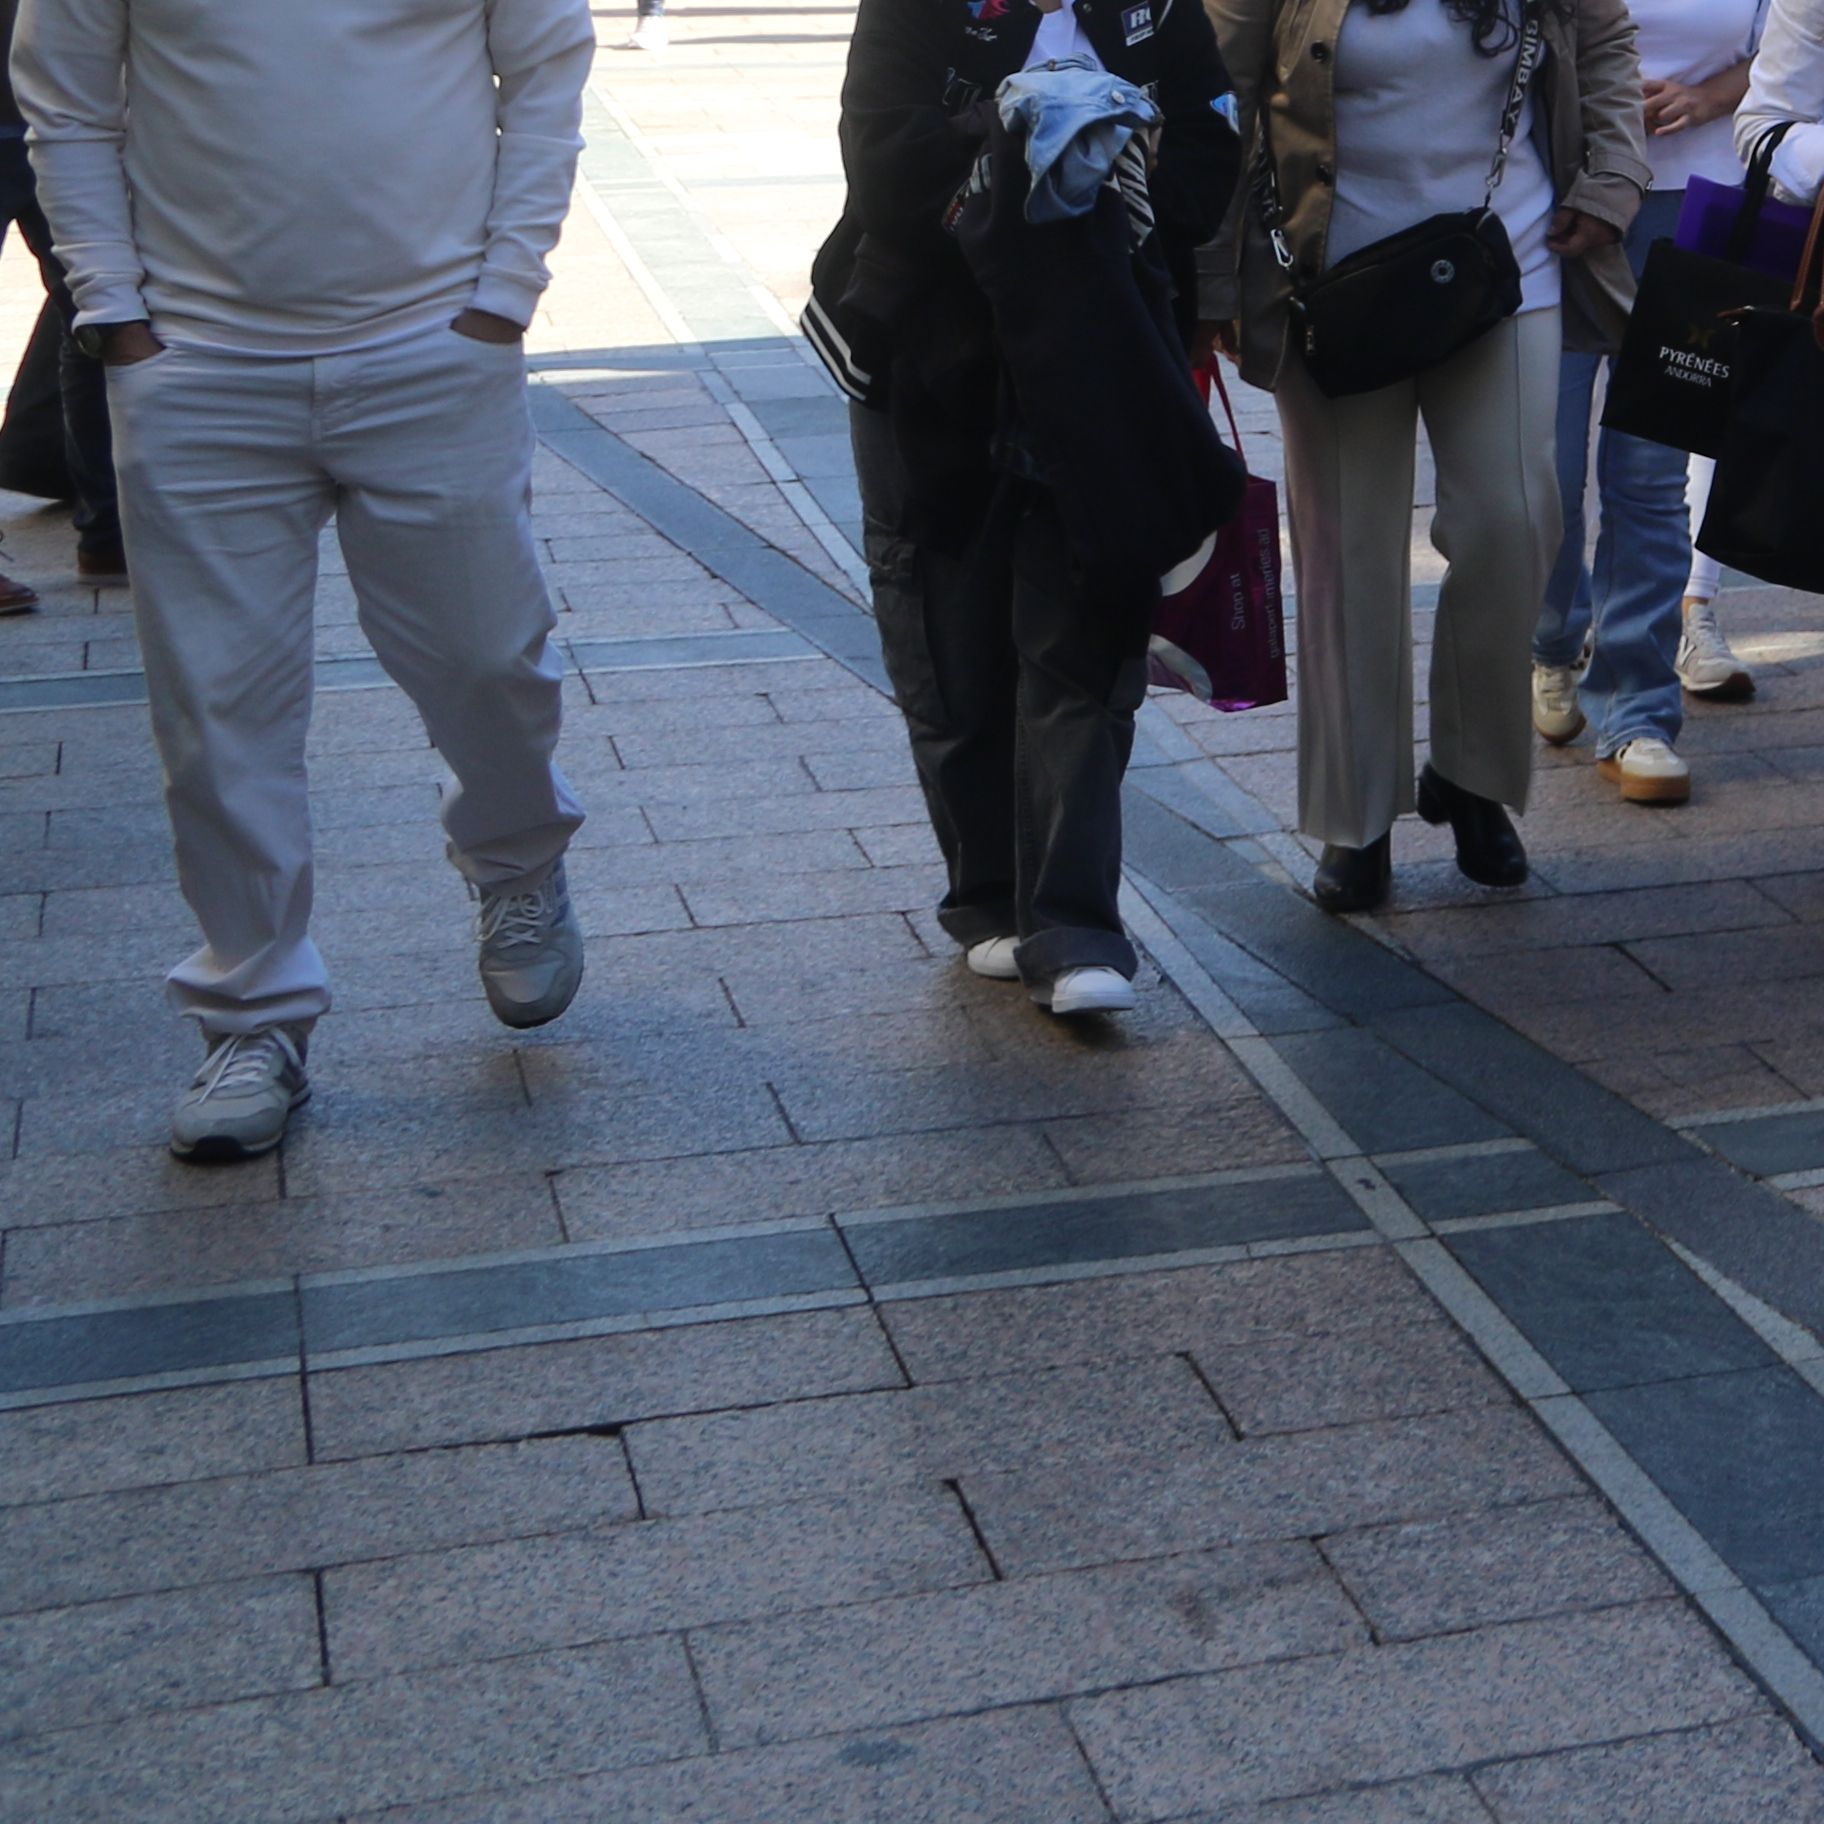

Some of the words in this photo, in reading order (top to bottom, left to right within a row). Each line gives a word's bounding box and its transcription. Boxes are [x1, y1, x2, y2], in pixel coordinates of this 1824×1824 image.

[1659, 346, 1730, 379] PYRÉNÉES
[1664, 365, 1713, 388] ANDORRA
[1230, 592, 1246, 631] Shop
